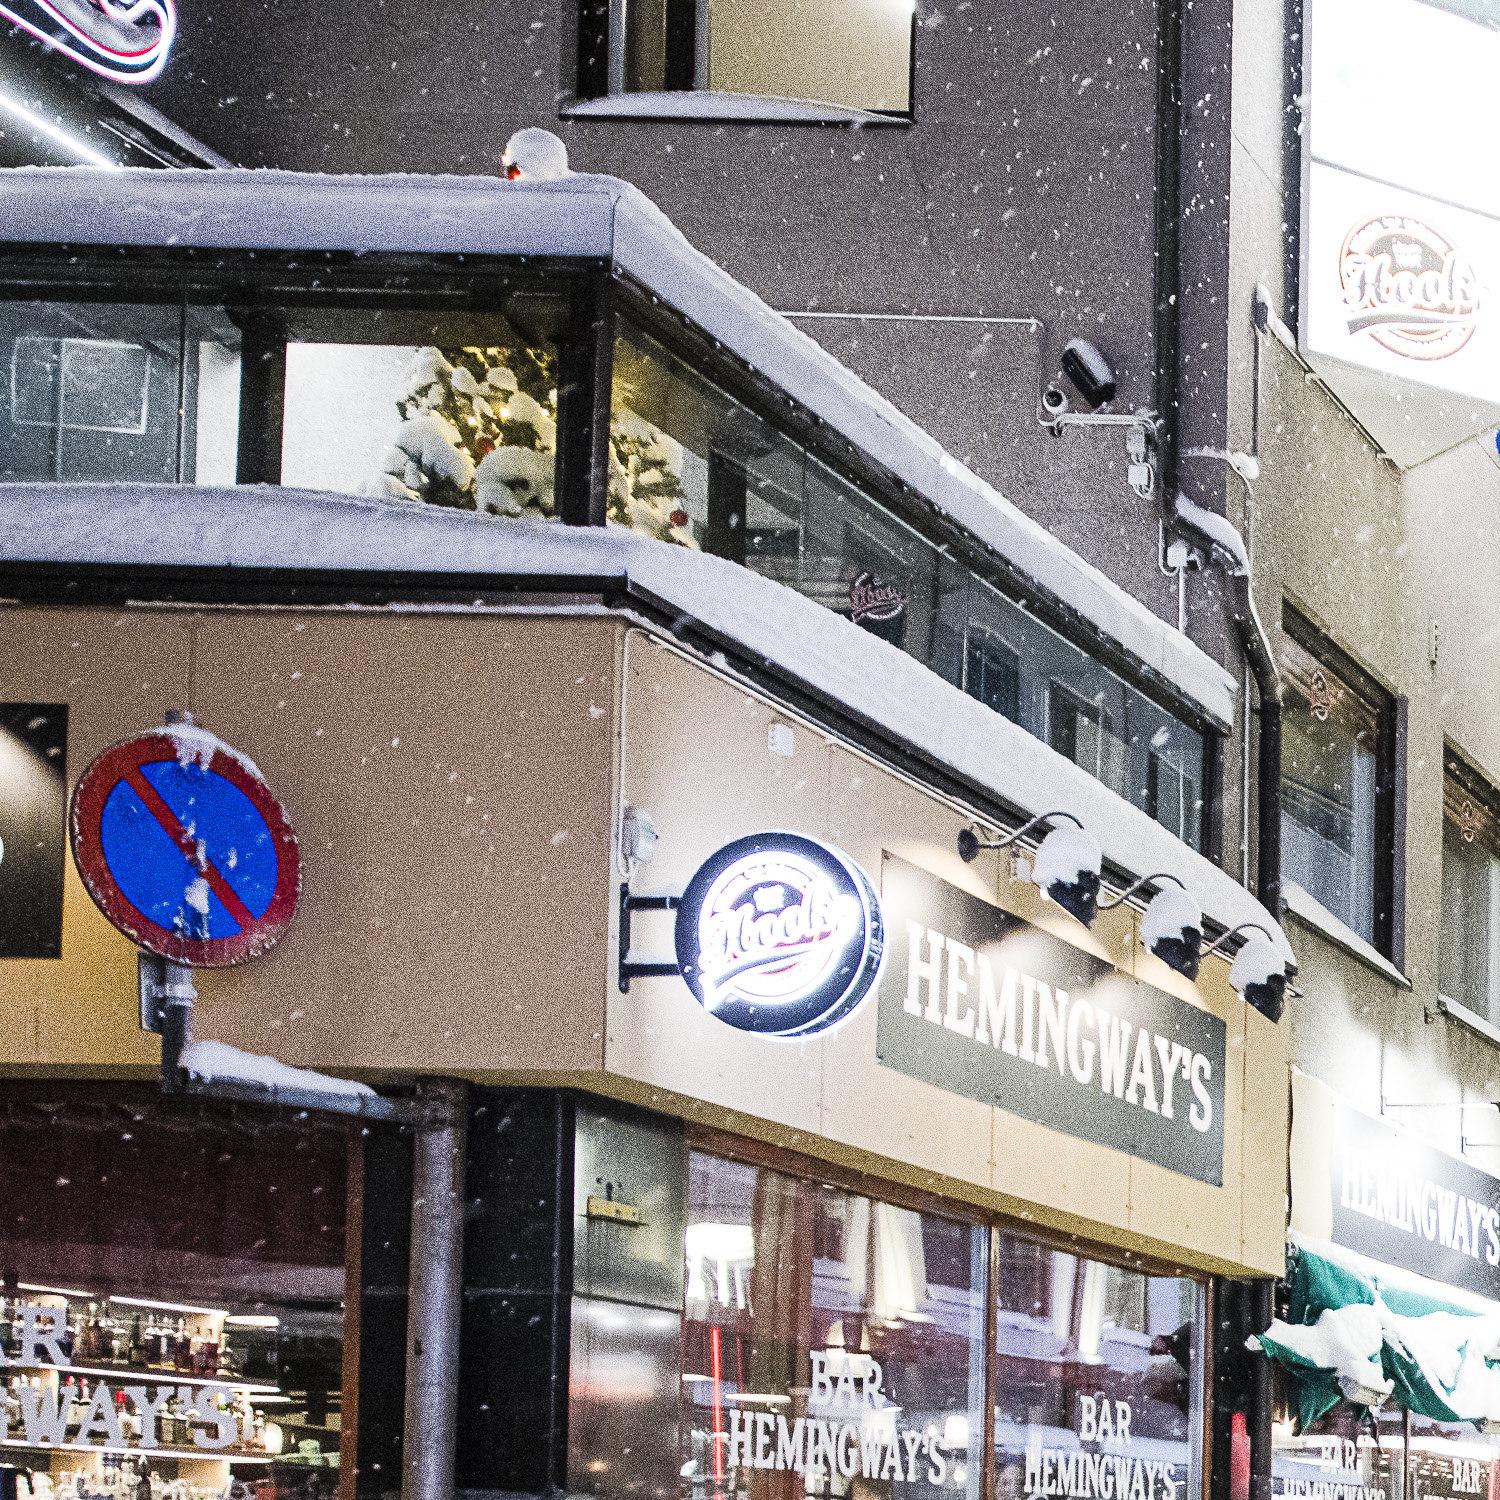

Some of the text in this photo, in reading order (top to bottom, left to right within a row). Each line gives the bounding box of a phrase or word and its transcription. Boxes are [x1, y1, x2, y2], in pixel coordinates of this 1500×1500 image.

[903, 918, 1214, 1134] HEMINGWAY'S
[1340, 1152, 1500, 1266] HEMINGWAY'S
[809, 1350, 885, 1411] BAR
[0, 1380, 238, 1450] WAY'S
[729, 1408, 947, 1486] HEMINGWAY'S
[1079, 1394, 1132, 1445] BAR
[1320, 1437, 1359, 1474] BAR
[1452, 1457, 1491, 1494] BAR
